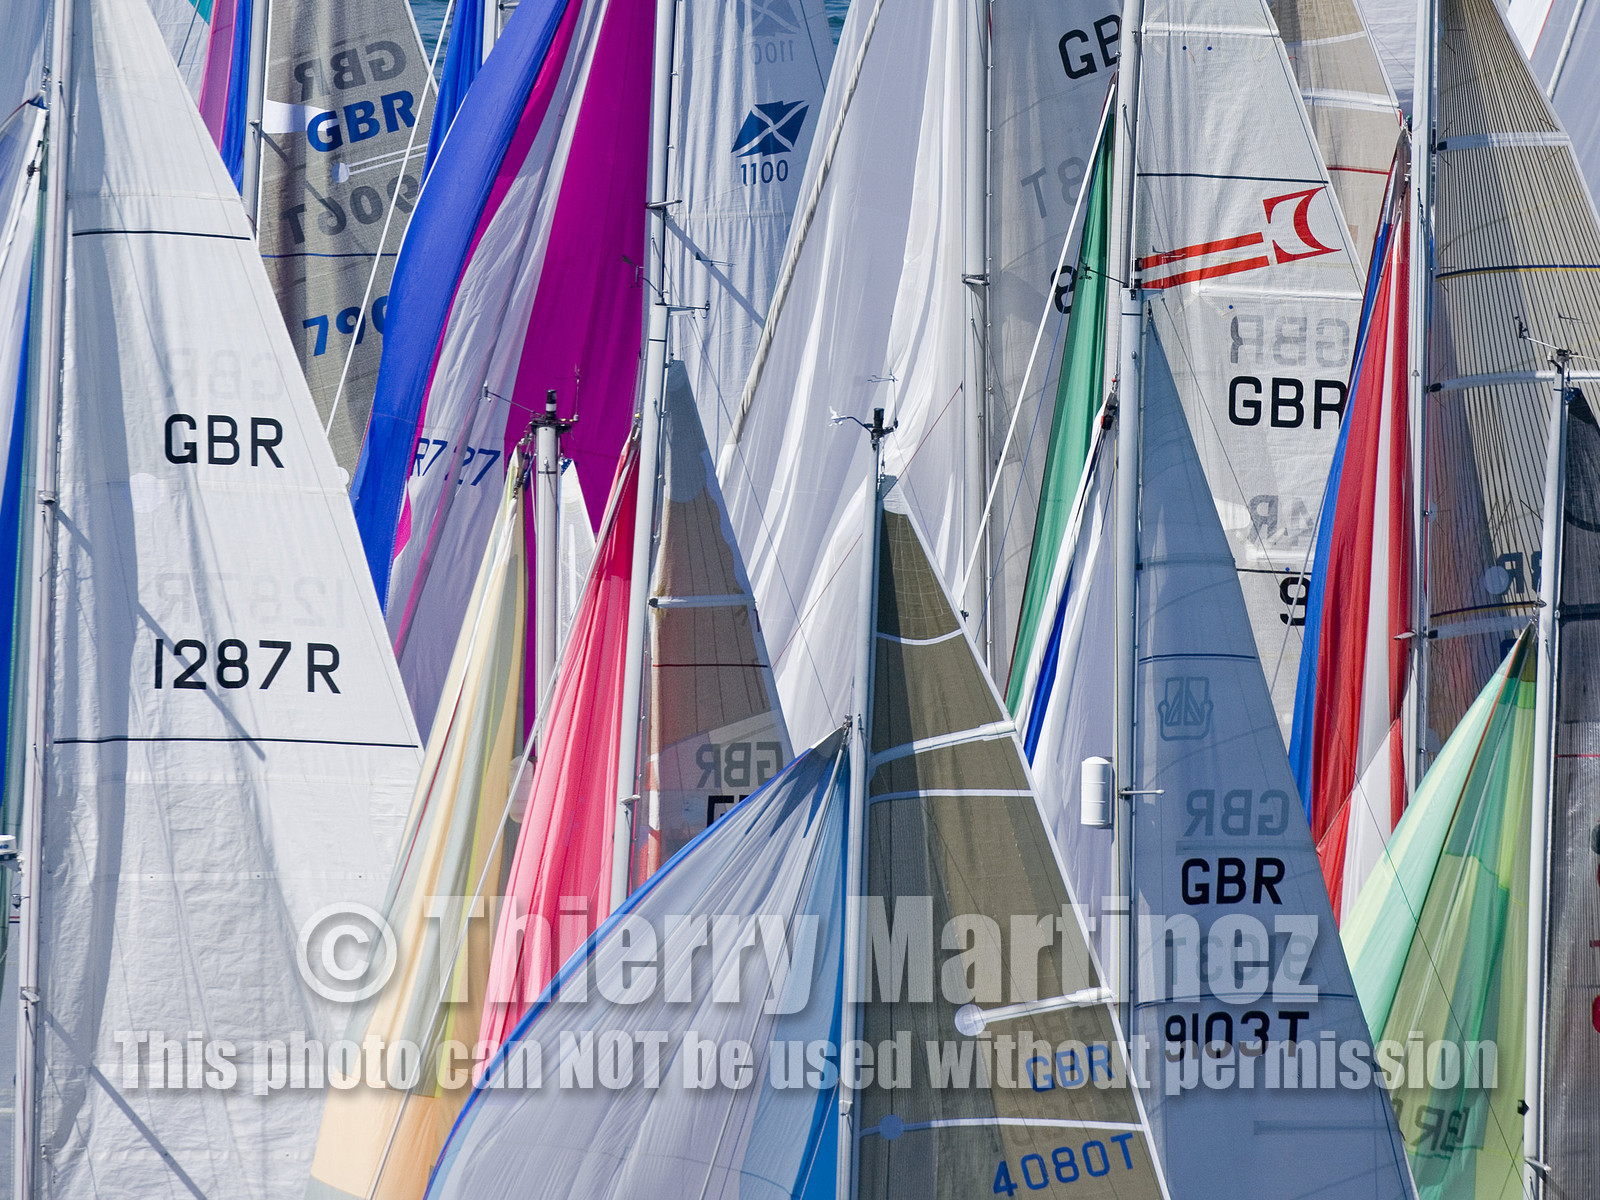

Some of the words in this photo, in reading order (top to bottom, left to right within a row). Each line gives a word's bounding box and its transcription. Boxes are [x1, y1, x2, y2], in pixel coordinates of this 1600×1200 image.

[306, 90, 416, 153] GBR
[740, 159, 789, 185] 1100
[1228, 375, 1349, 430] GBR
[164, 413, 284, 469] GBR
[1181, 857, 1286, 906] GBR
[1164, 1009, 1310, 1064] 9103T
[1025, 1043, 1115, 1093] GBR
[992, 1132, 1134, 1198] 4080T
